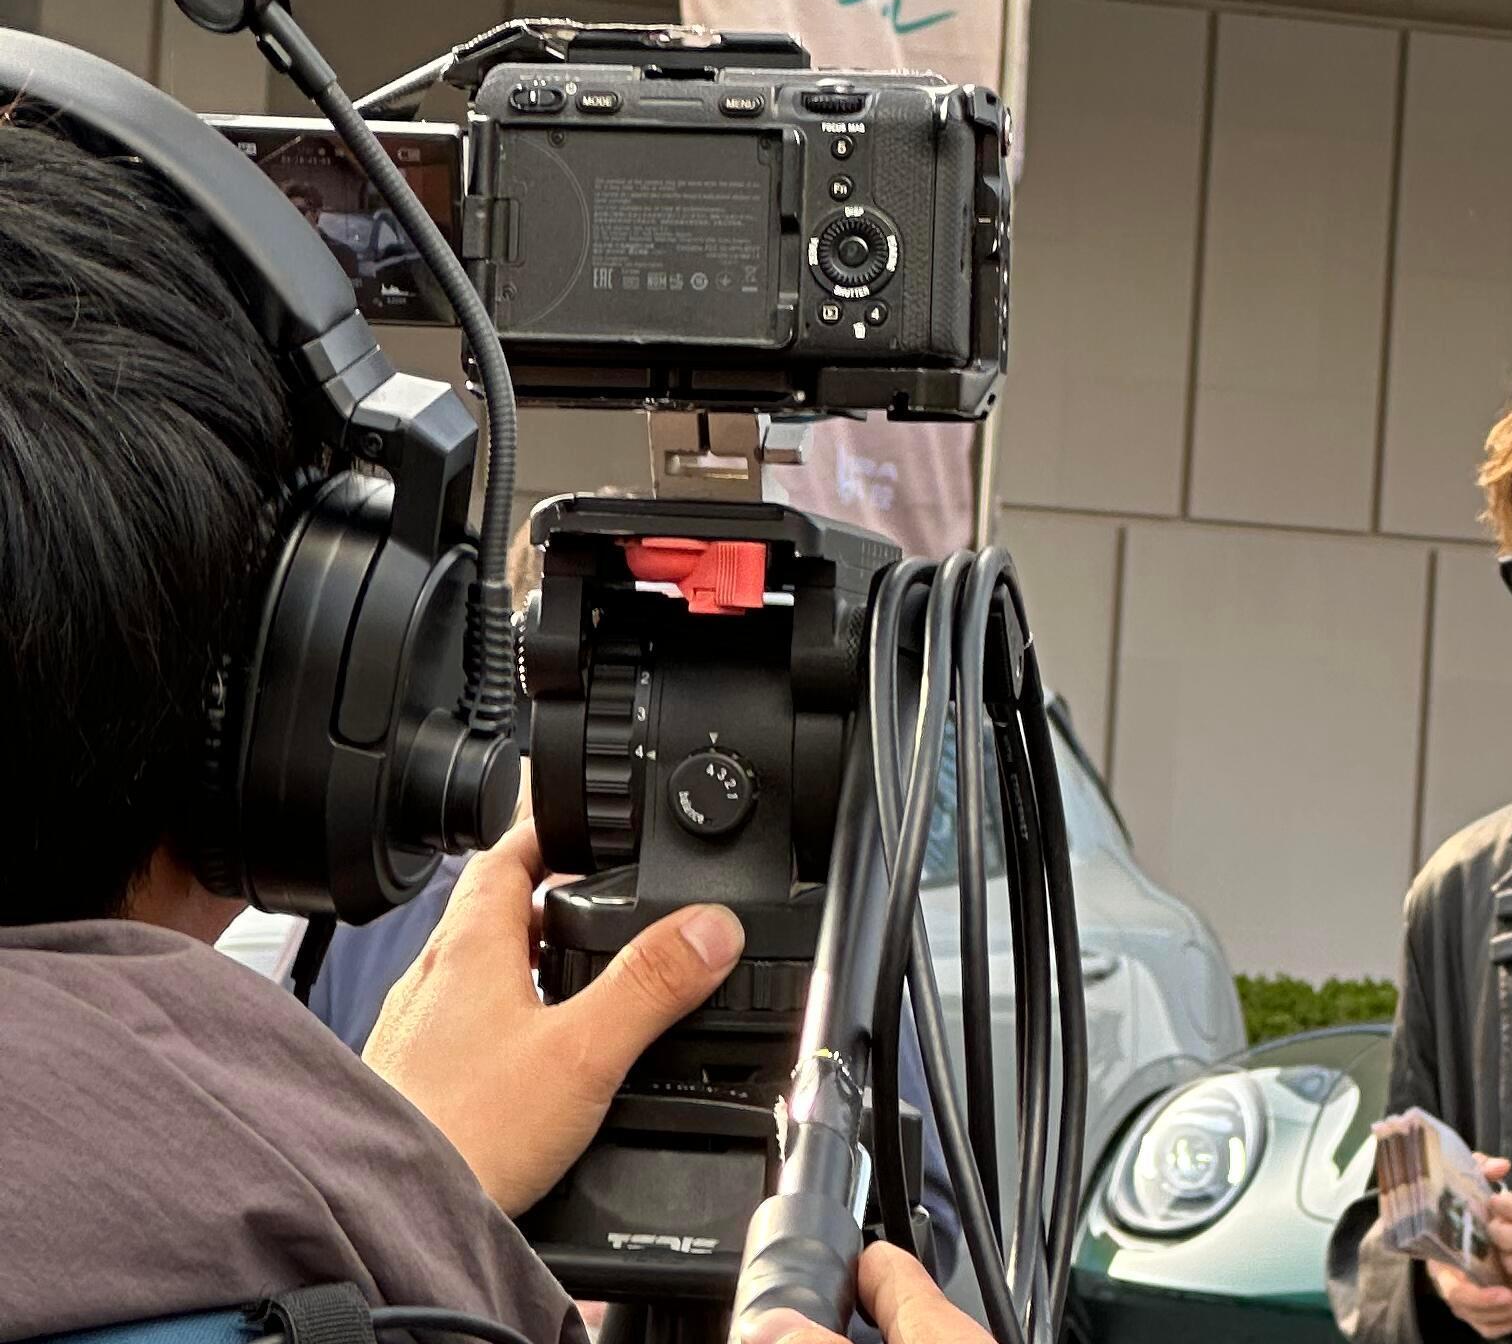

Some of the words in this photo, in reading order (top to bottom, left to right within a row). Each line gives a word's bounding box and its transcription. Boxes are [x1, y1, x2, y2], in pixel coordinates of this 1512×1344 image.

[582, 95, 611, 107] MODE
[726, 98, 756, 110] MENU
[833, 182, 848, 195] Fn
[640, 671, 650, 685] 2
[636, 706, 646, 722] 3
[634, 744, 644, 759] 4
